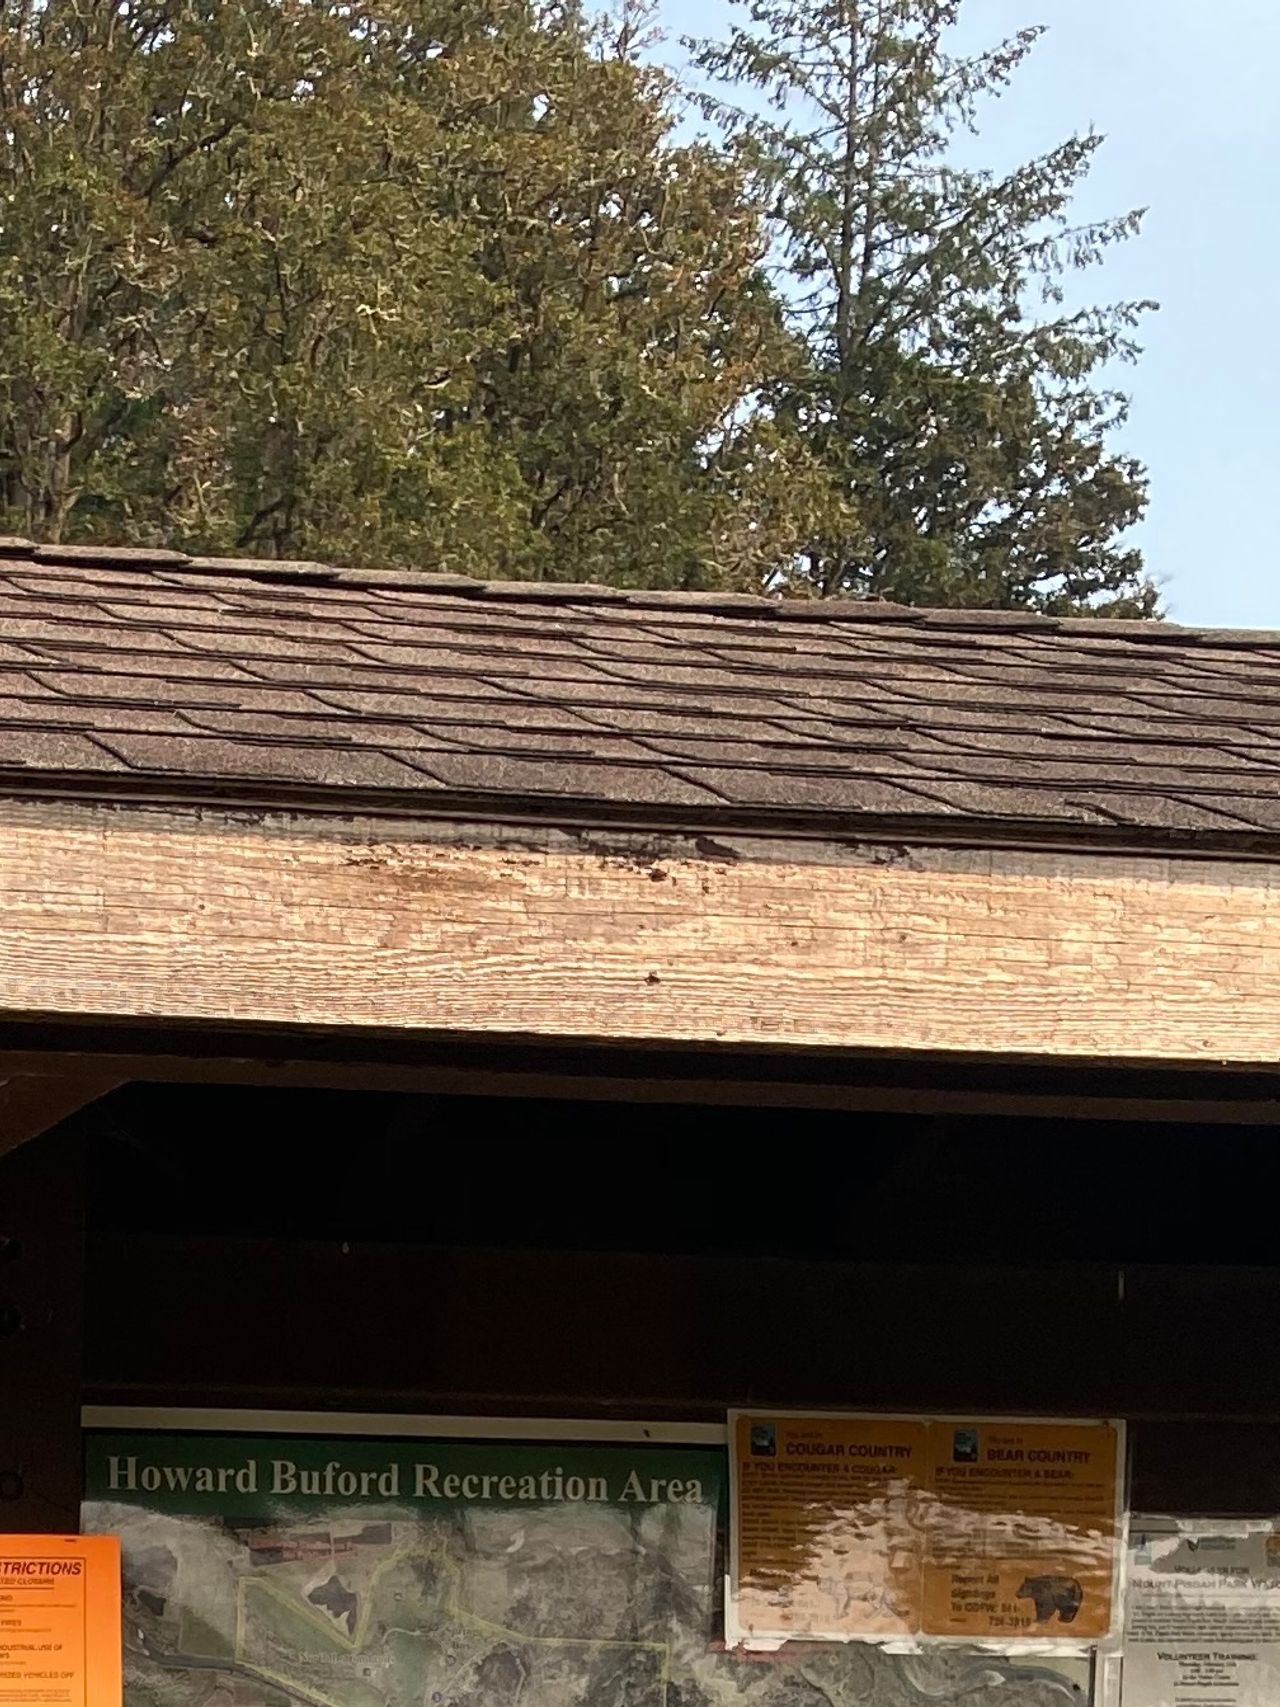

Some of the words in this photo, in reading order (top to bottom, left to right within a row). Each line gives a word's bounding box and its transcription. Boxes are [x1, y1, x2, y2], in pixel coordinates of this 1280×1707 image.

[786, 1443, 845, 1456] COUGAR
[848, 1445, 913, 1458] COUNTRY
[987, 1449, 1024, 1461] BEAR
[1027, 1451, 1090, 1464] COUNTRY
[106, 1455, 257, 1493] Howard
[269, 1460, 401, 1497] Buford
[413, 1465, 608, 1501] Recreation
[617, 1470, 704, 1505] Area
